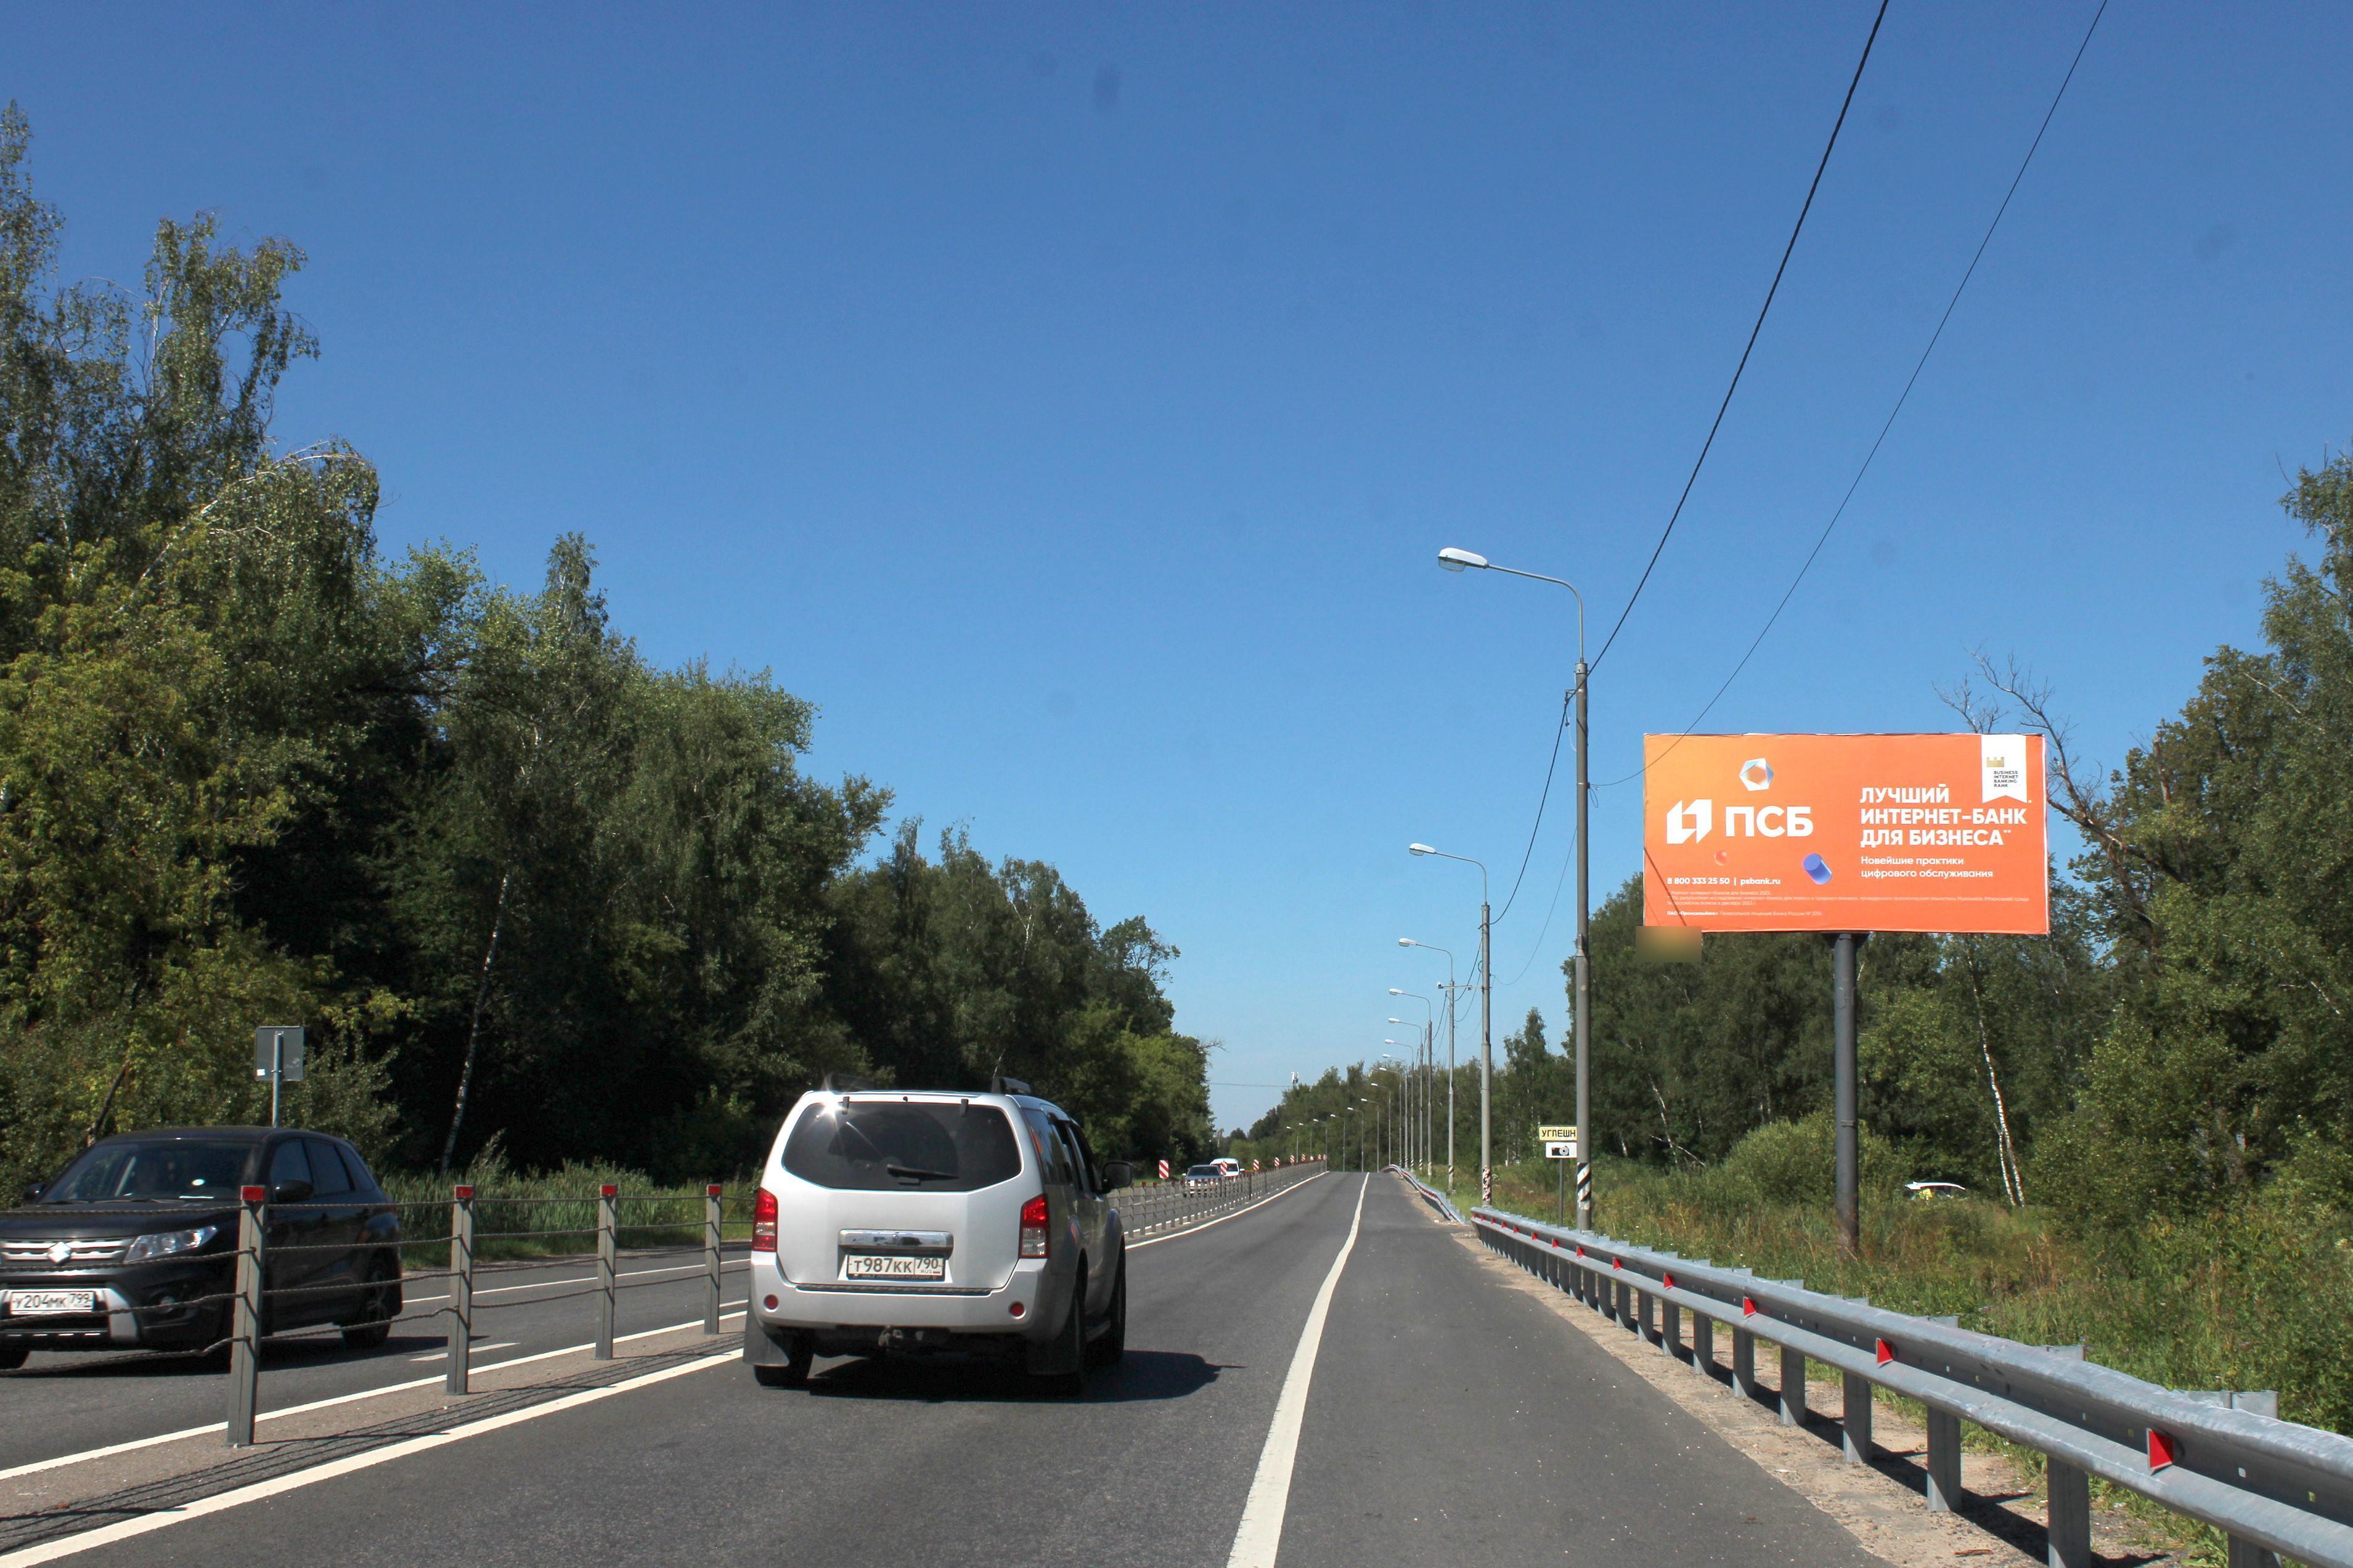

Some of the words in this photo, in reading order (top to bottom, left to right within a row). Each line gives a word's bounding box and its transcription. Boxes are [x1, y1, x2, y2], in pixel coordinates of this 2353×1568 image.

[1860, 783, 1949, 803] ЛУЧШИЙ
[1725, 805, 1814, 838] ПСБ
[1861, 808, 2028, 824] ИНТЕРНЕТ-БАНК
[1860, 829, 1903, 848] ДЛЯ
[1861, 855, 1914, 865] Новейшие
[1916, 857, 1964, 867] практики
[1861, 868, 1917, 879] цифрового
[1919, 869, 1993, 880] обслуживания
[1666, 877, 1673, 885] 8
[1674, 877, 1690, 885] 800
[1692, 877, 1707, 885] 333
[1708, 877, 1718, 885] 25
[1719, 877, 1730, 885] 50
[1740, 877, 1781, 887] psbank.ru
[1541, 1129, 1576, 1137] УГЛЕШН
[854, 1257, 912, 1273] Т987КК
[917, 1257, 939, 1269] 790
[69, 1293, 90, 1304] 799
